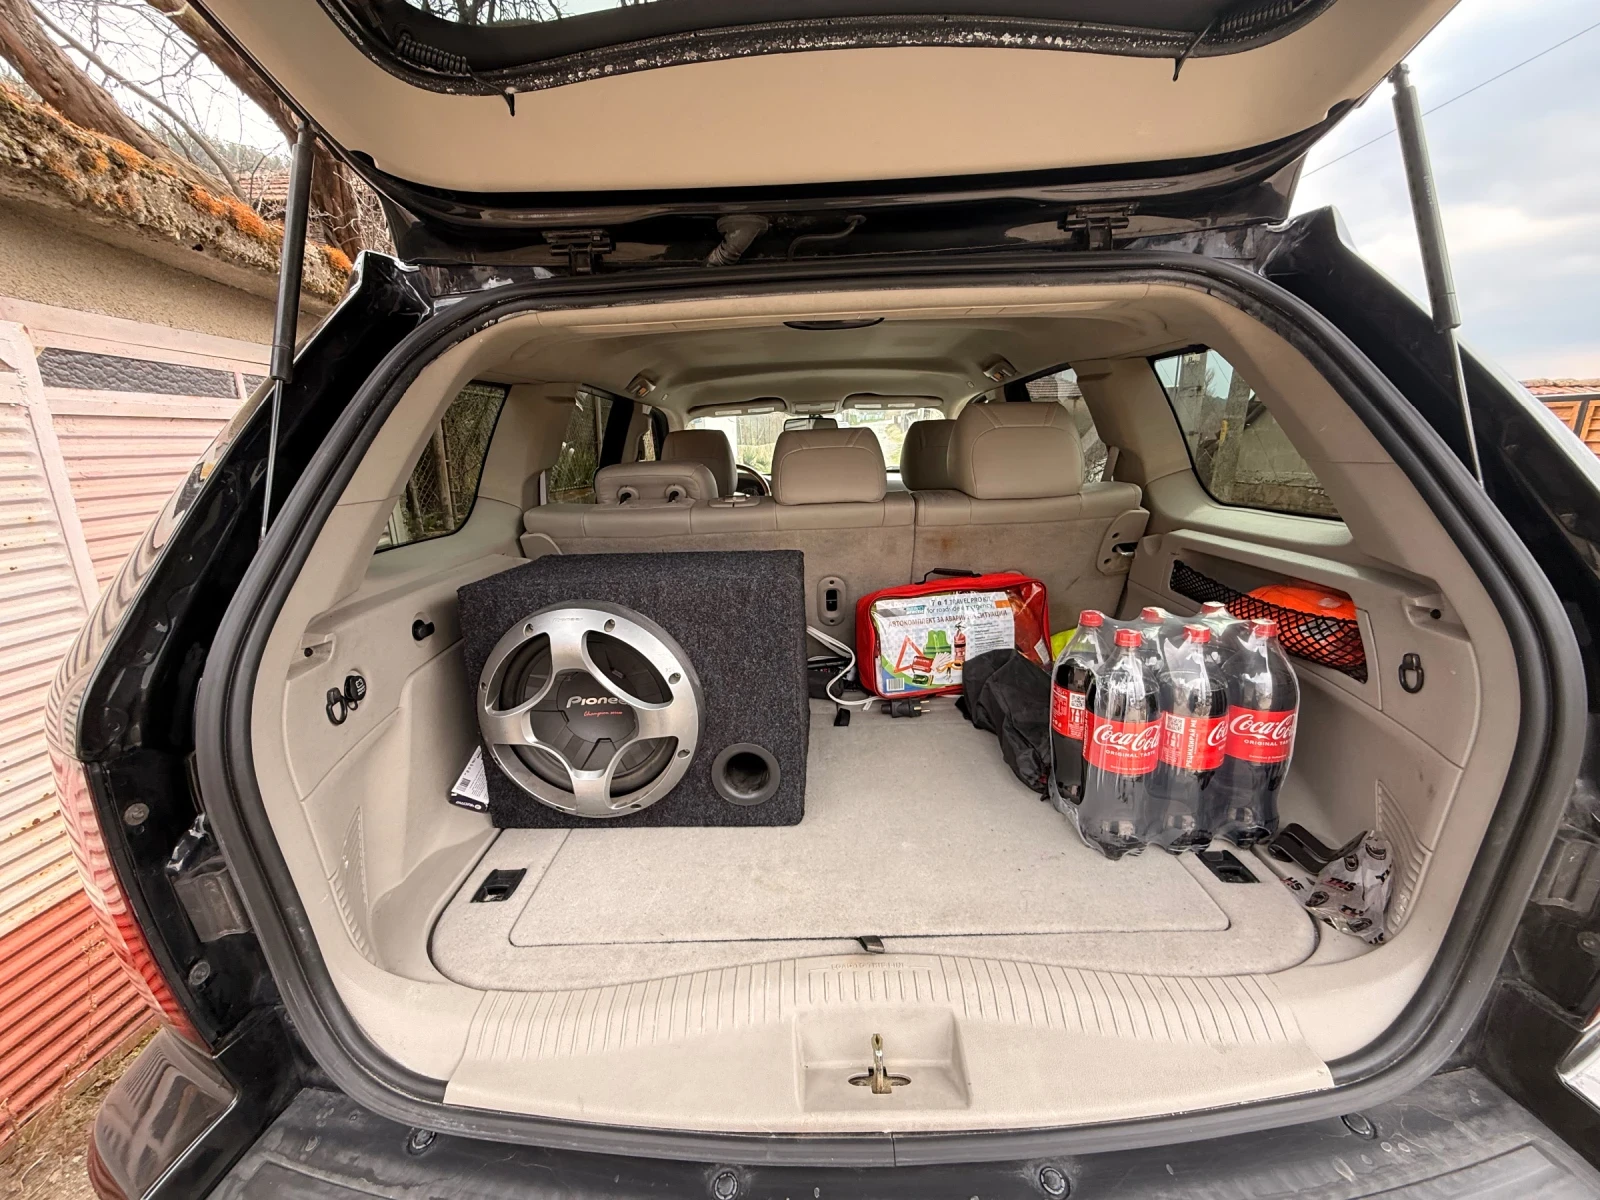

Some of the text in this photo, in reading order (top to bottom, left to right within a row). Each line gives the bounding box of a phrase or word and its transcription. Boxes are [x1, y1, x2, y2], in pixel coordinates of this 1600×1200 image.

[566, 695, 629, 708] Pionee
[1229, 713, 1296, 740] Coca-Co
[1105, 749, 1139, 758] ORIGINAL
